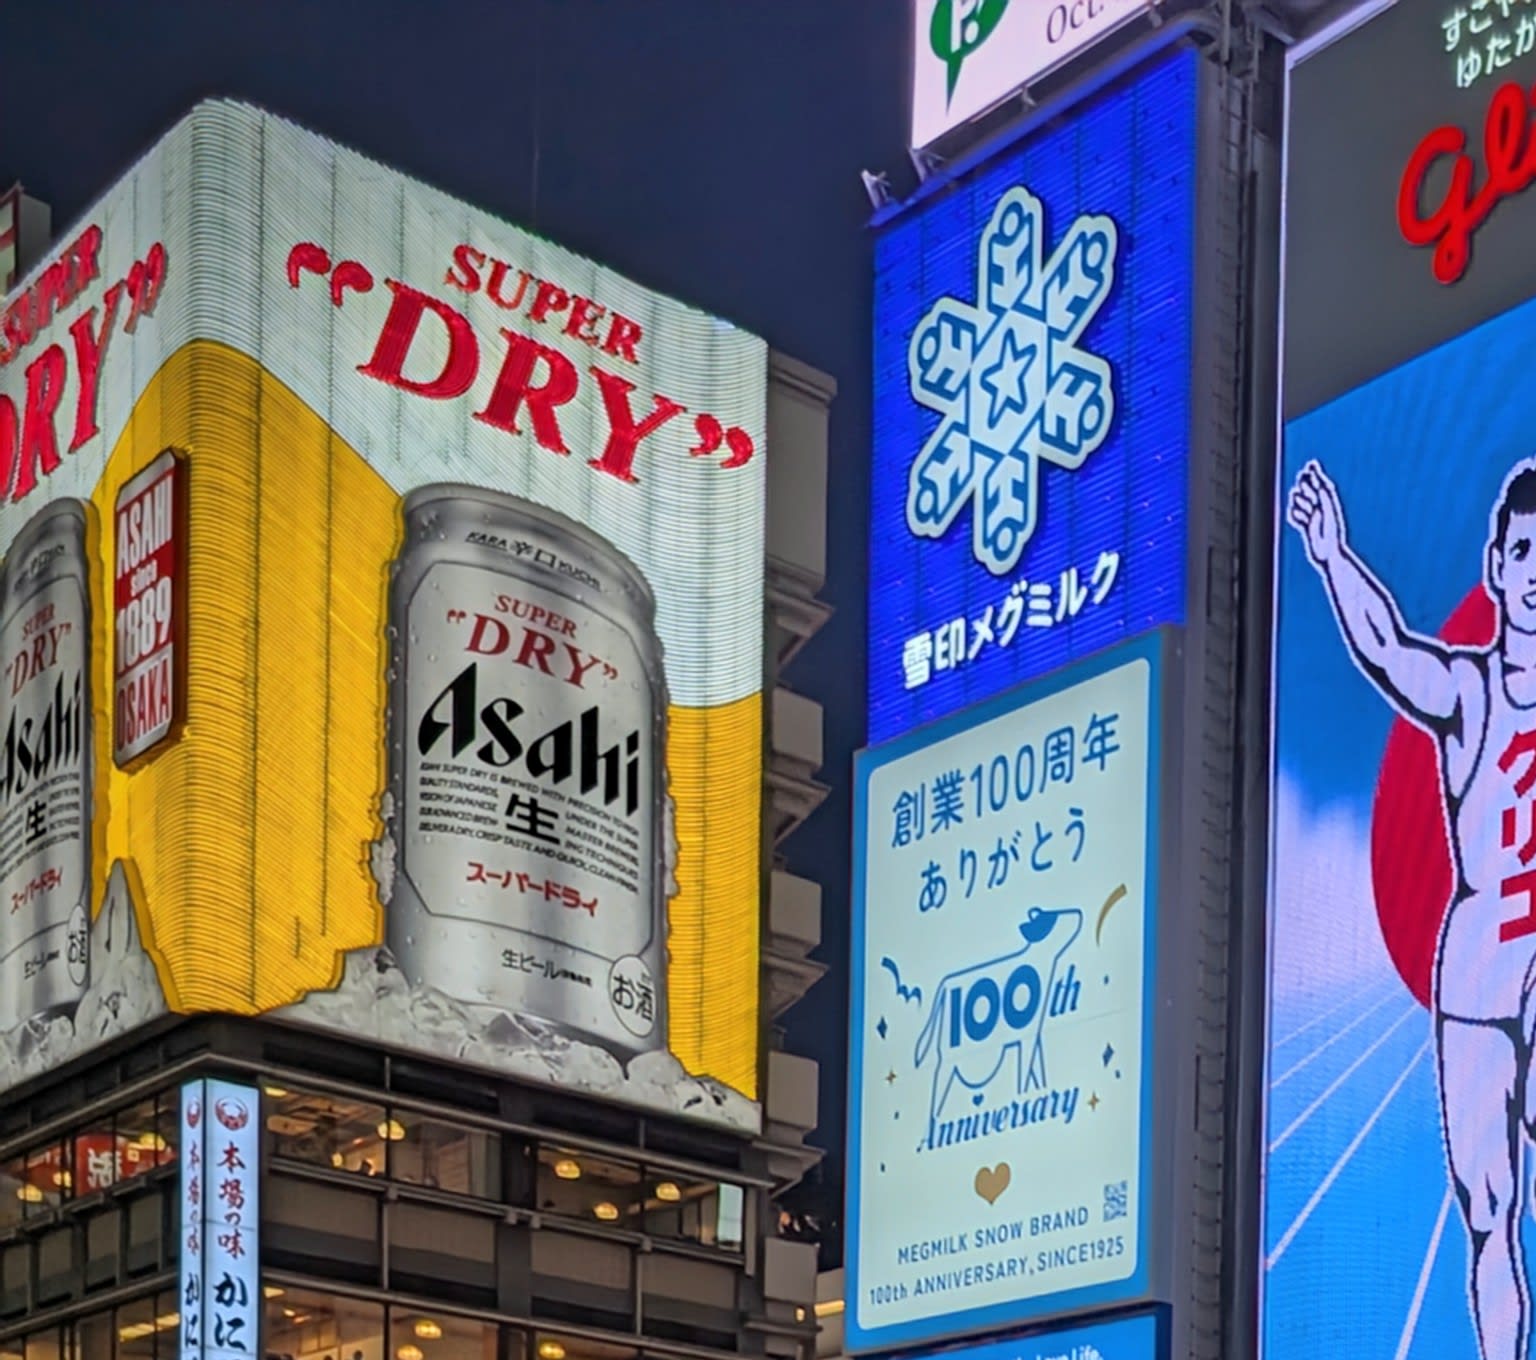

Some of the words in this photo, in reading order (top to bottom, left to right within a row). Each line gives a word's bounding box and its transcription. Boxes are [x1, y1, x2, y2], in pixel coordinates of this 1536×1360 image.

[444, 244, 645, 365] SUPER
[115, 482, 173, 580] ASAHI
[116, 575, 172, 672] 1889
[494, 594, 577, 638] SUPER
[903, 550, 1120, 689] 雪印メグミルク
[118, 658, 169, 752] OSAKA
[418, 662, 639, 817] Asahi
[25, 799, 47, 845] 生
[504, 792, 560, 845] 生
[891, 713, 1121, 848] 創業100周年
[465, 861, 599, 917] スーパードライ
[919, 807, 1086, 912] ありがとう
[501, 949, 560, 980] 生ビール
[612, 970, 655, 1022] お酒
[949, 963, 1083, 1048] 100th
[916, 1085, 1081, 1154] Anniversary
[217, 1140, 246, 1261] 本場の味
[897, 1232, 968, 1266] MEGMILK
[974, 1219, 1023, 1250] SNOW
[1029, 1205, 1089, 1239] BRAND
[869, 1273, 908, 1306] 100th
